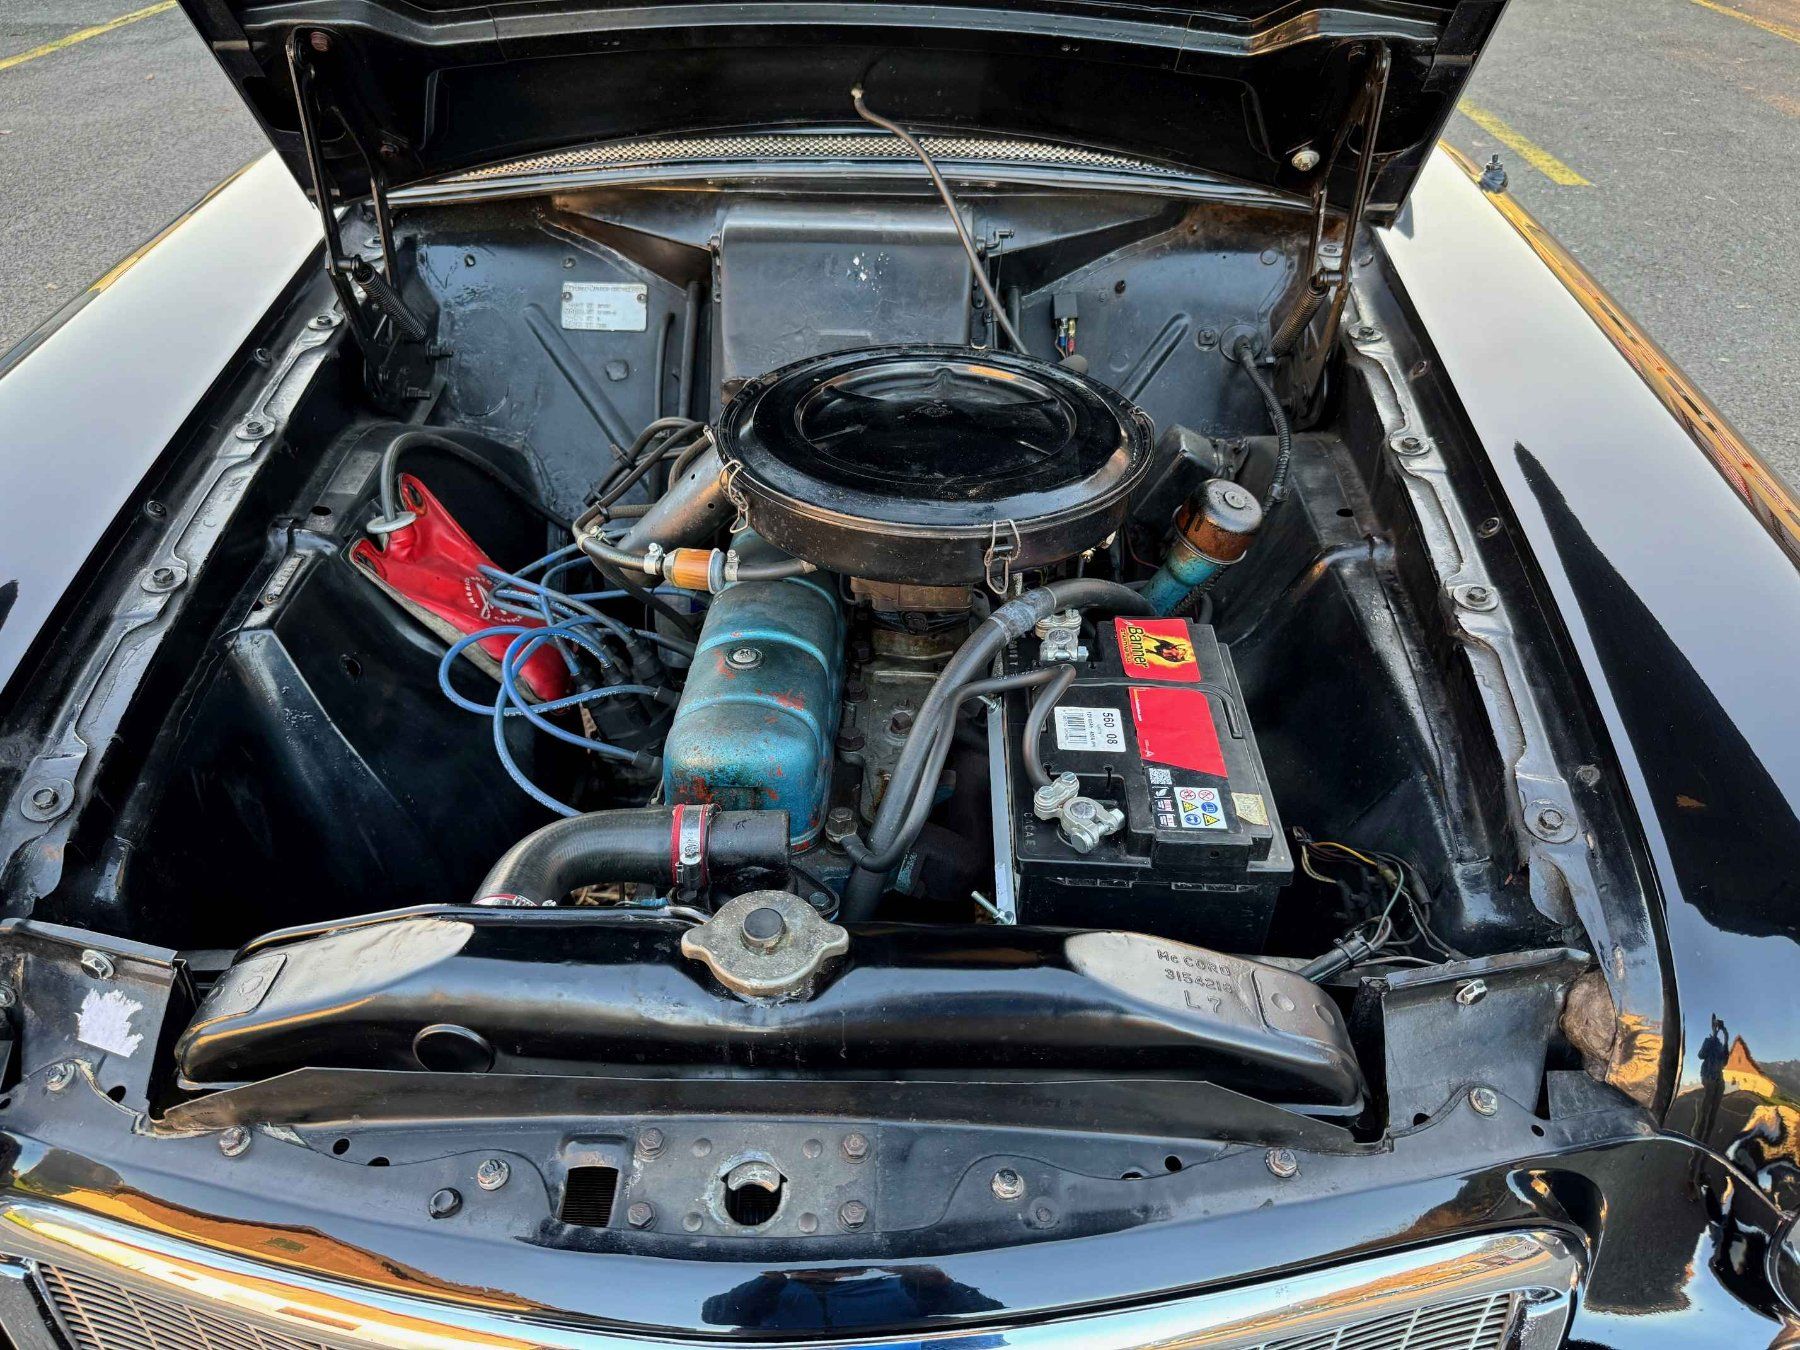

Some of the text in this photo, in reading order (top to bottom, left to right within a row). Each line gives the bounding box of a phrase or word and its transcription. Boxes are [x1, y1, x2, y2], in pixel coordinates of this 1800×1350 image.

[1127, 626, 1149, 669] Banner
[1102, 712, 1119, 745] 560 08
[1183, 955, 1231, 977] CORD
[1183, 989, 1222, 1014] L 7
